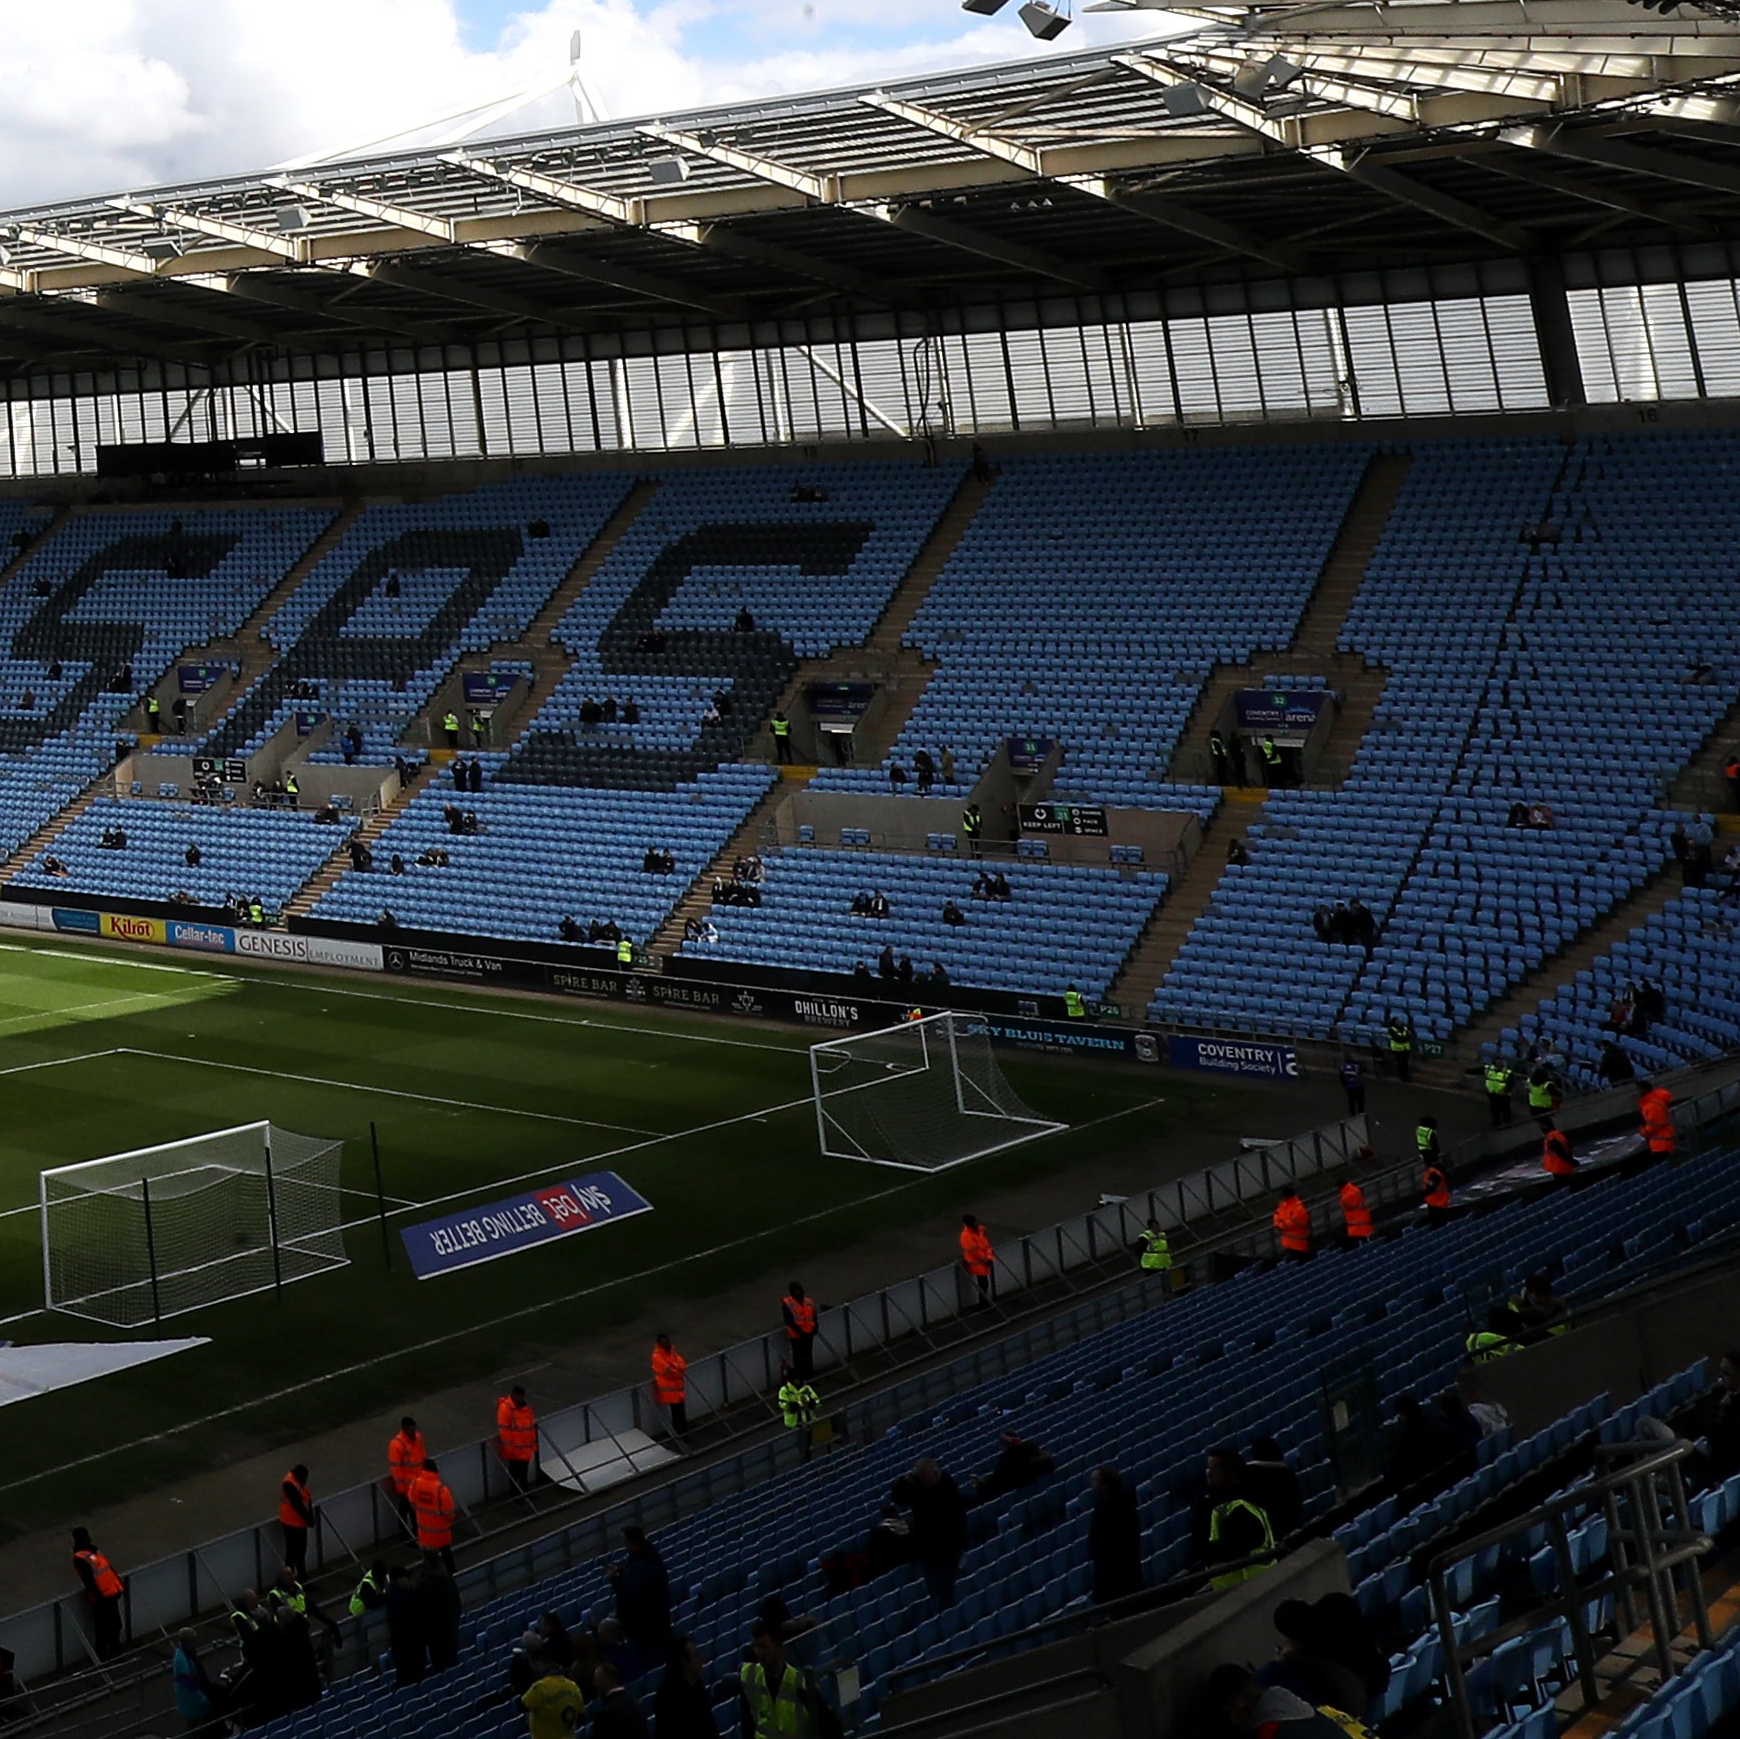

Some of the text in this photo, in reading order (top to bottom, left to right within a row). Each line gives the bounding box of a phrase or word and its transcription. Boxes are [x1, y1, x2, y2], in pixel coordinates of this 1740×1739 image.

[111, 917, 151, 938] Kilrot
[174, 924, 225, 946] Cellar-tec
[239, 934, 379, 966] GENESIS EMPLOYMENT
[408, 950, 449, 965] Midlands
[449, 955, 474, 969] Truck
[475, 959, 484, 970] &
[485, 962, 503, 972] Van
[553, 971, 618, 992] SPIRE BAR
[652, 984, 690, 1001] SPIRE
[693, 990, 721, 1005] BAR
[794, 999, 859, 1021] DHILLON'S
[804, 1014, 851, 1028] BREWERY
[1054, 1032, 1125, 1051] TAVERN
[1424, 1043, 1442, 1056] P27
[1197, 1042, 1274, 1063] COVENTRY
[1199, 1056, 1240, 1073] Building
[1240, 1060, 1276, 1076] Society
[428, 1183, 613, 1257] sky bet BETTING BETTER
